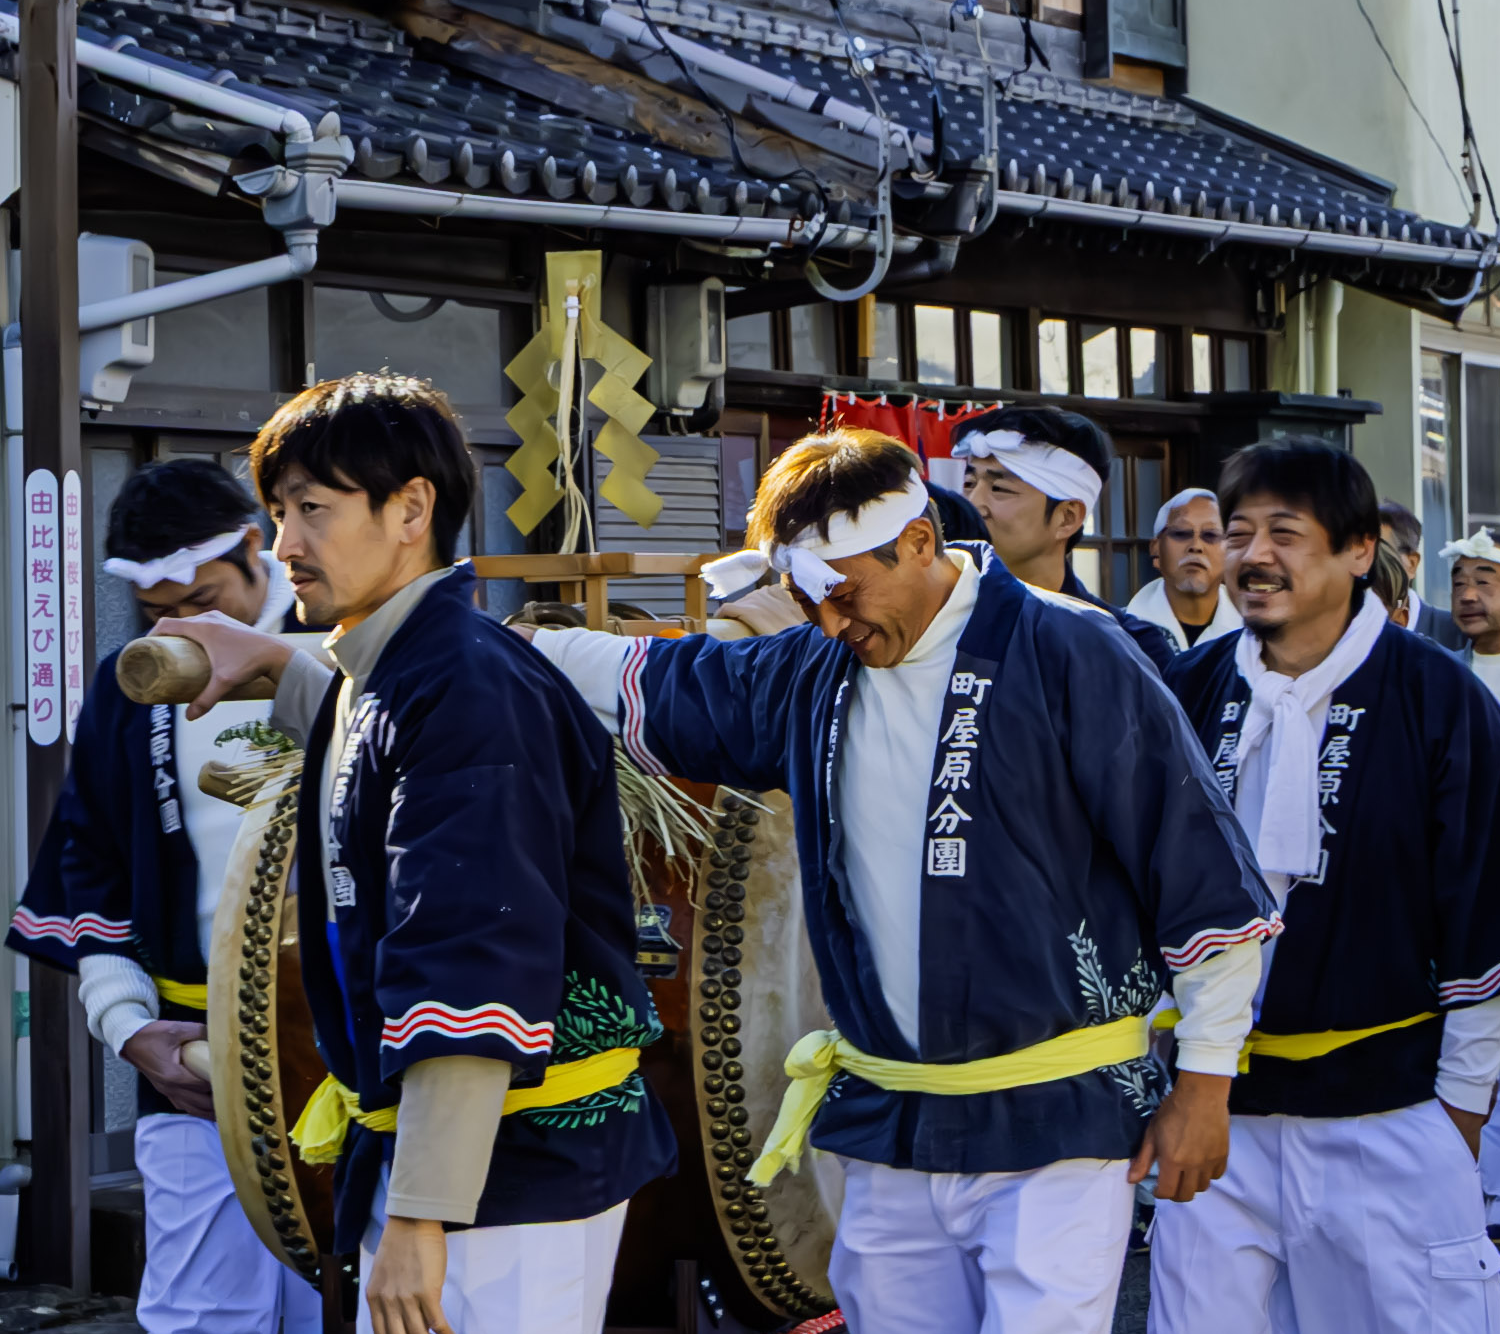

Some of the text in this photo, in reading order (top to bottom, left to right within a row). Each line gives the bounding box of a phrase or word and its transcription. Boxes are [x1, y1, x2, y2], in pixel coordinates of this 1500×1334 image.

[30, 490, 55, 722] 由比桜えび通り
[66, 492, 83, 725] 由比桜えび通り
[927, 671, 993, 878] 町屋原分團
